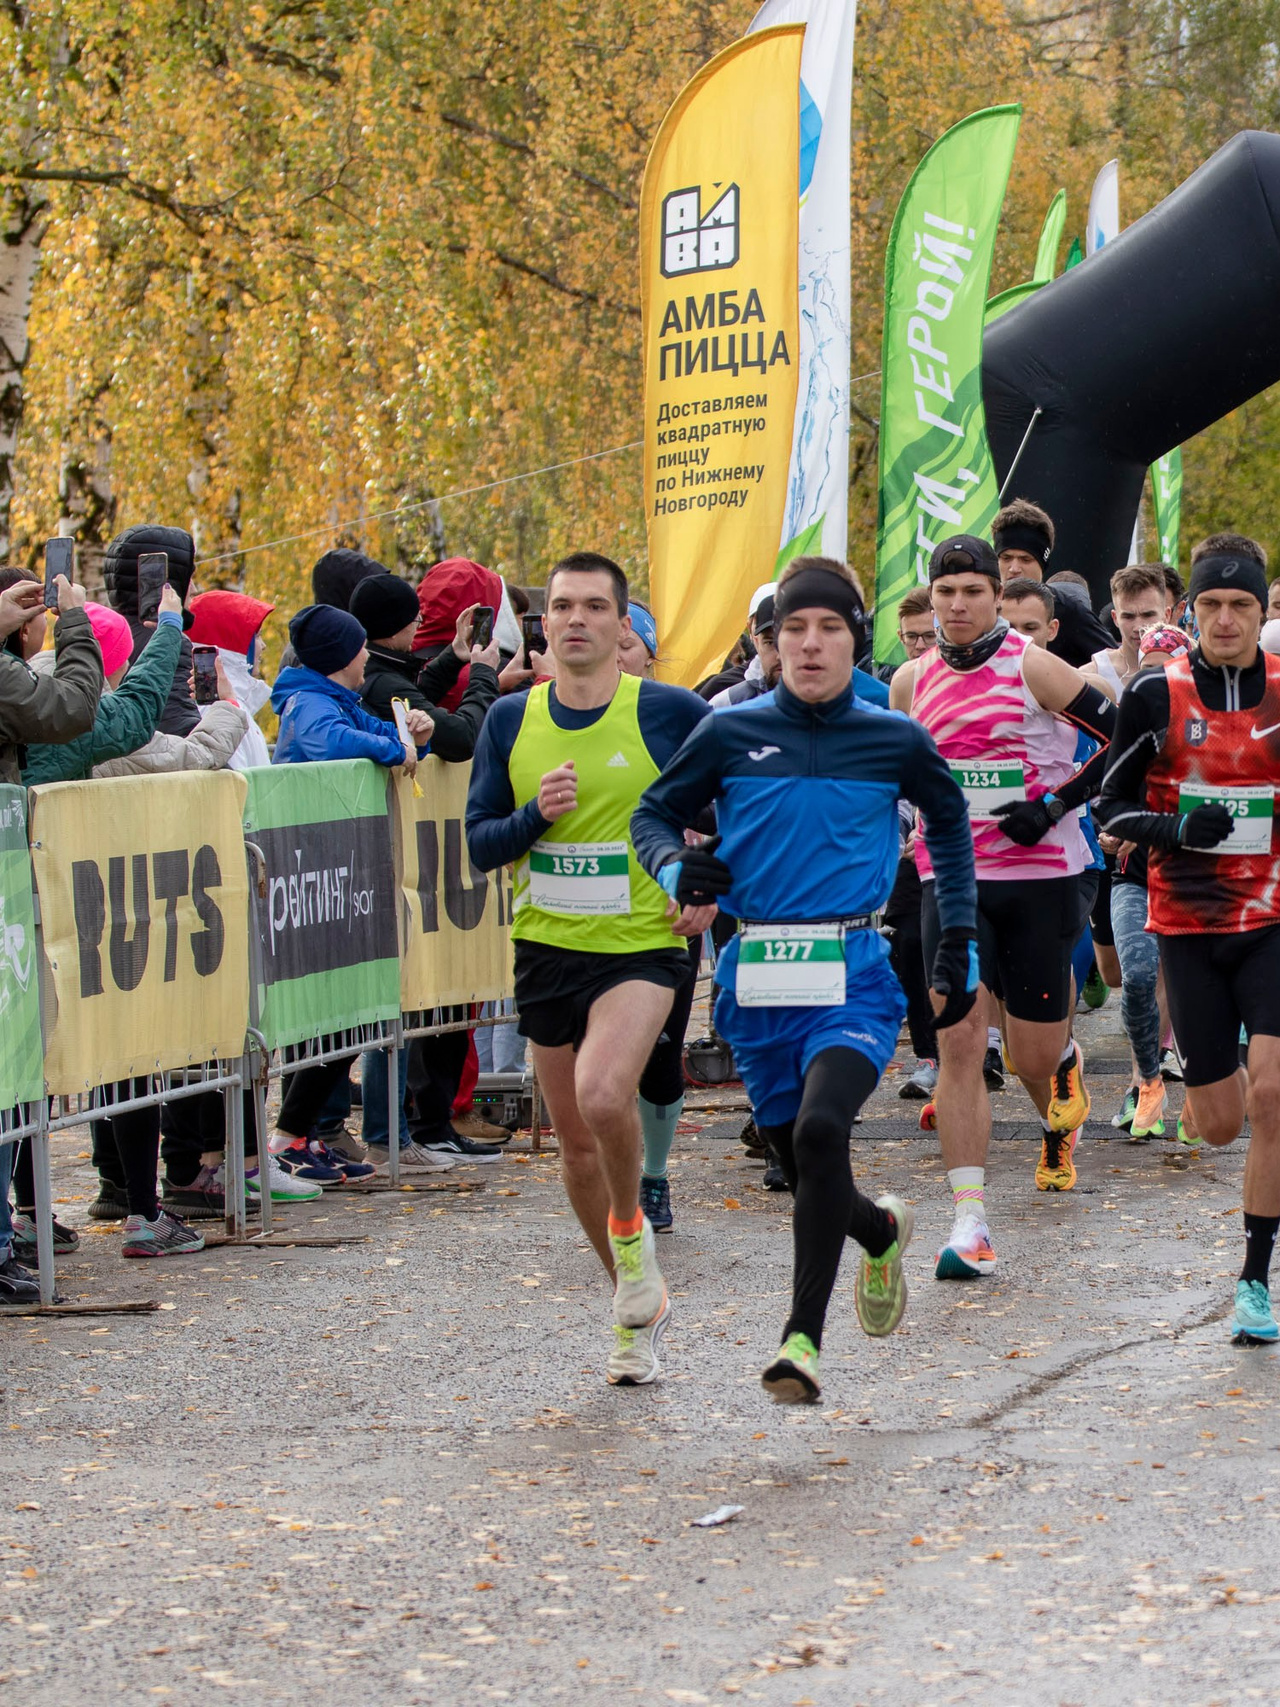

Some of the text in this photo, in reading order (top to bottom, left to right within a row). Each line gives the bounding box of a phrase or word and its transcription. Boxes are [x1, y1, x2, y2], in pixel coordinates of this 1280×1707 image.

[658, 288, 766, 338] АМБА
[907, 211, 976, 437] ГЕРОЙ!
[659, 330, 791, 381] ПИЦЦА
[656, 394, 768, 427] Доставляем
[657, 416, 766, 446] квадратную
[656, 447, 710, 471] пиццу
[655, 464, 765, 494] по Нижнему
[654, 489, 749, 517] Новгороду
[962, 772, 1001, 787] 1234
[1204, 799, 1250, 817] 95
[552, 856, 600, 875] 1573
[72, 844, 225, 998] RUTS
[763, 941, 815, 961] 1277
